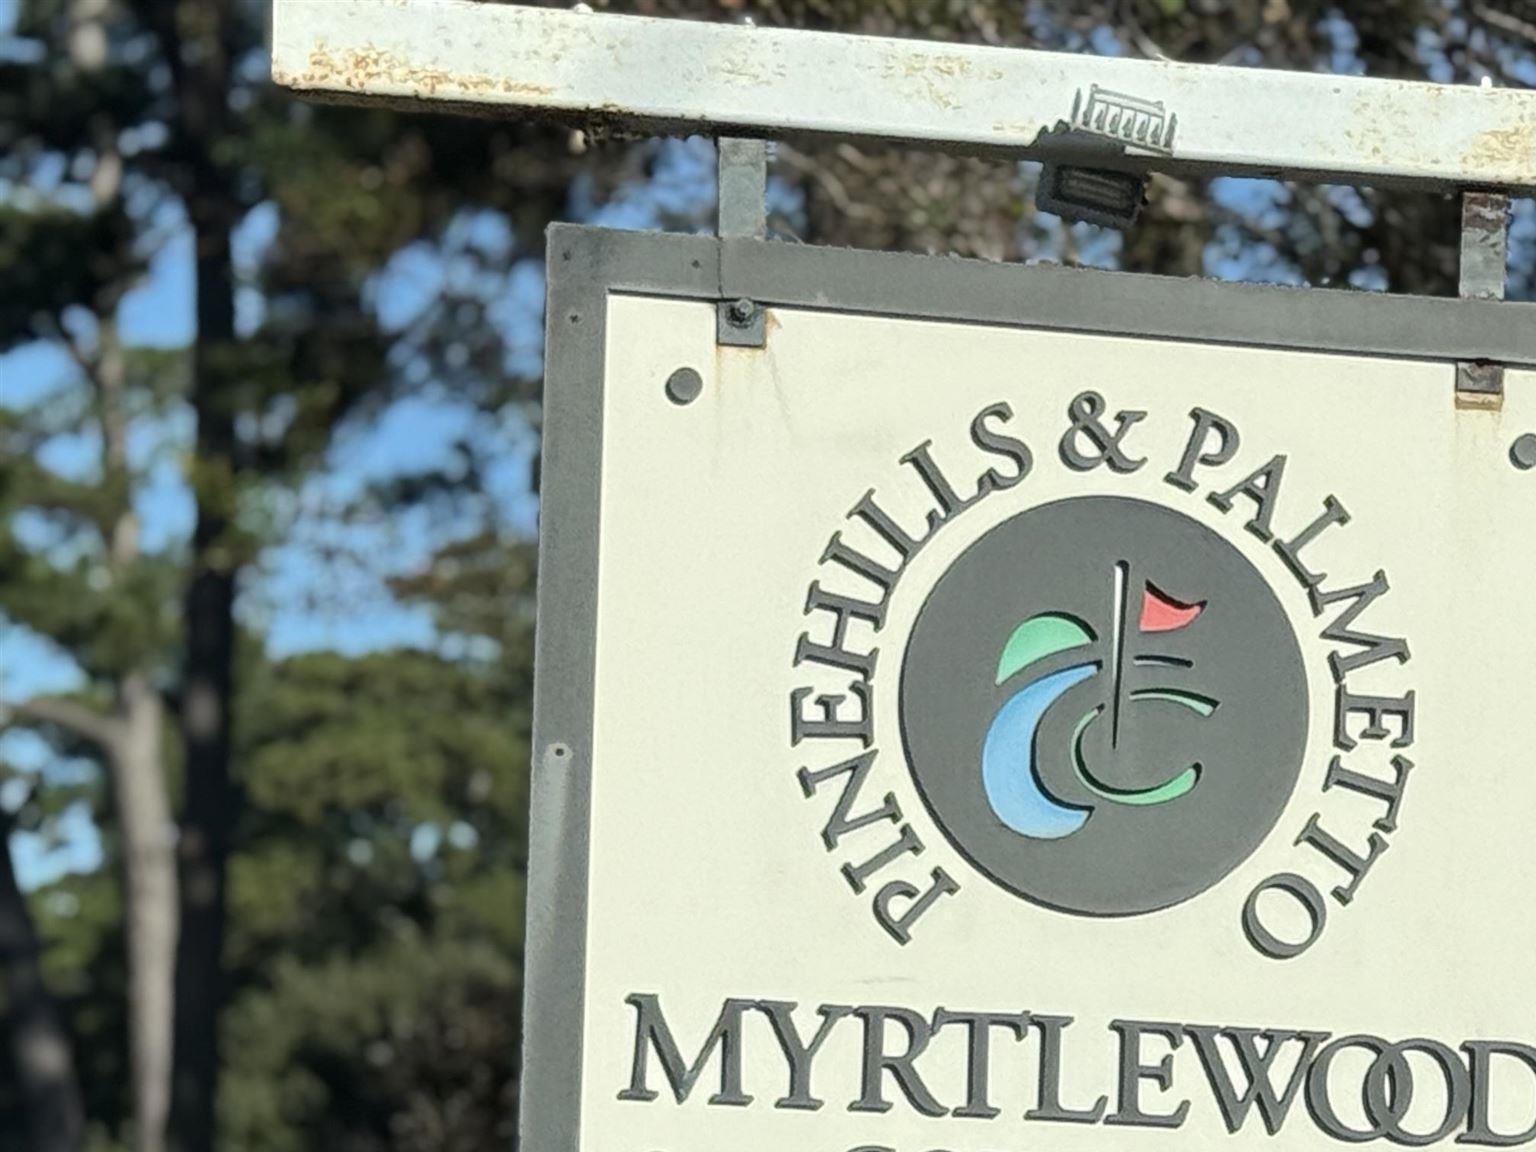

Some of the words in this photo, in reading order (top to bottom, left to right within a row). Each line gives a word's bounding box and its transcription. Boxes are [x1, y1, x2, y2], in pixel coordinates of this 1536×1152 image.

[790, 401, 1033, 946] PINEHILLS
[1058, 390, 1148, 474] &
[1163, 406, 1415, 960] PALMETTO
